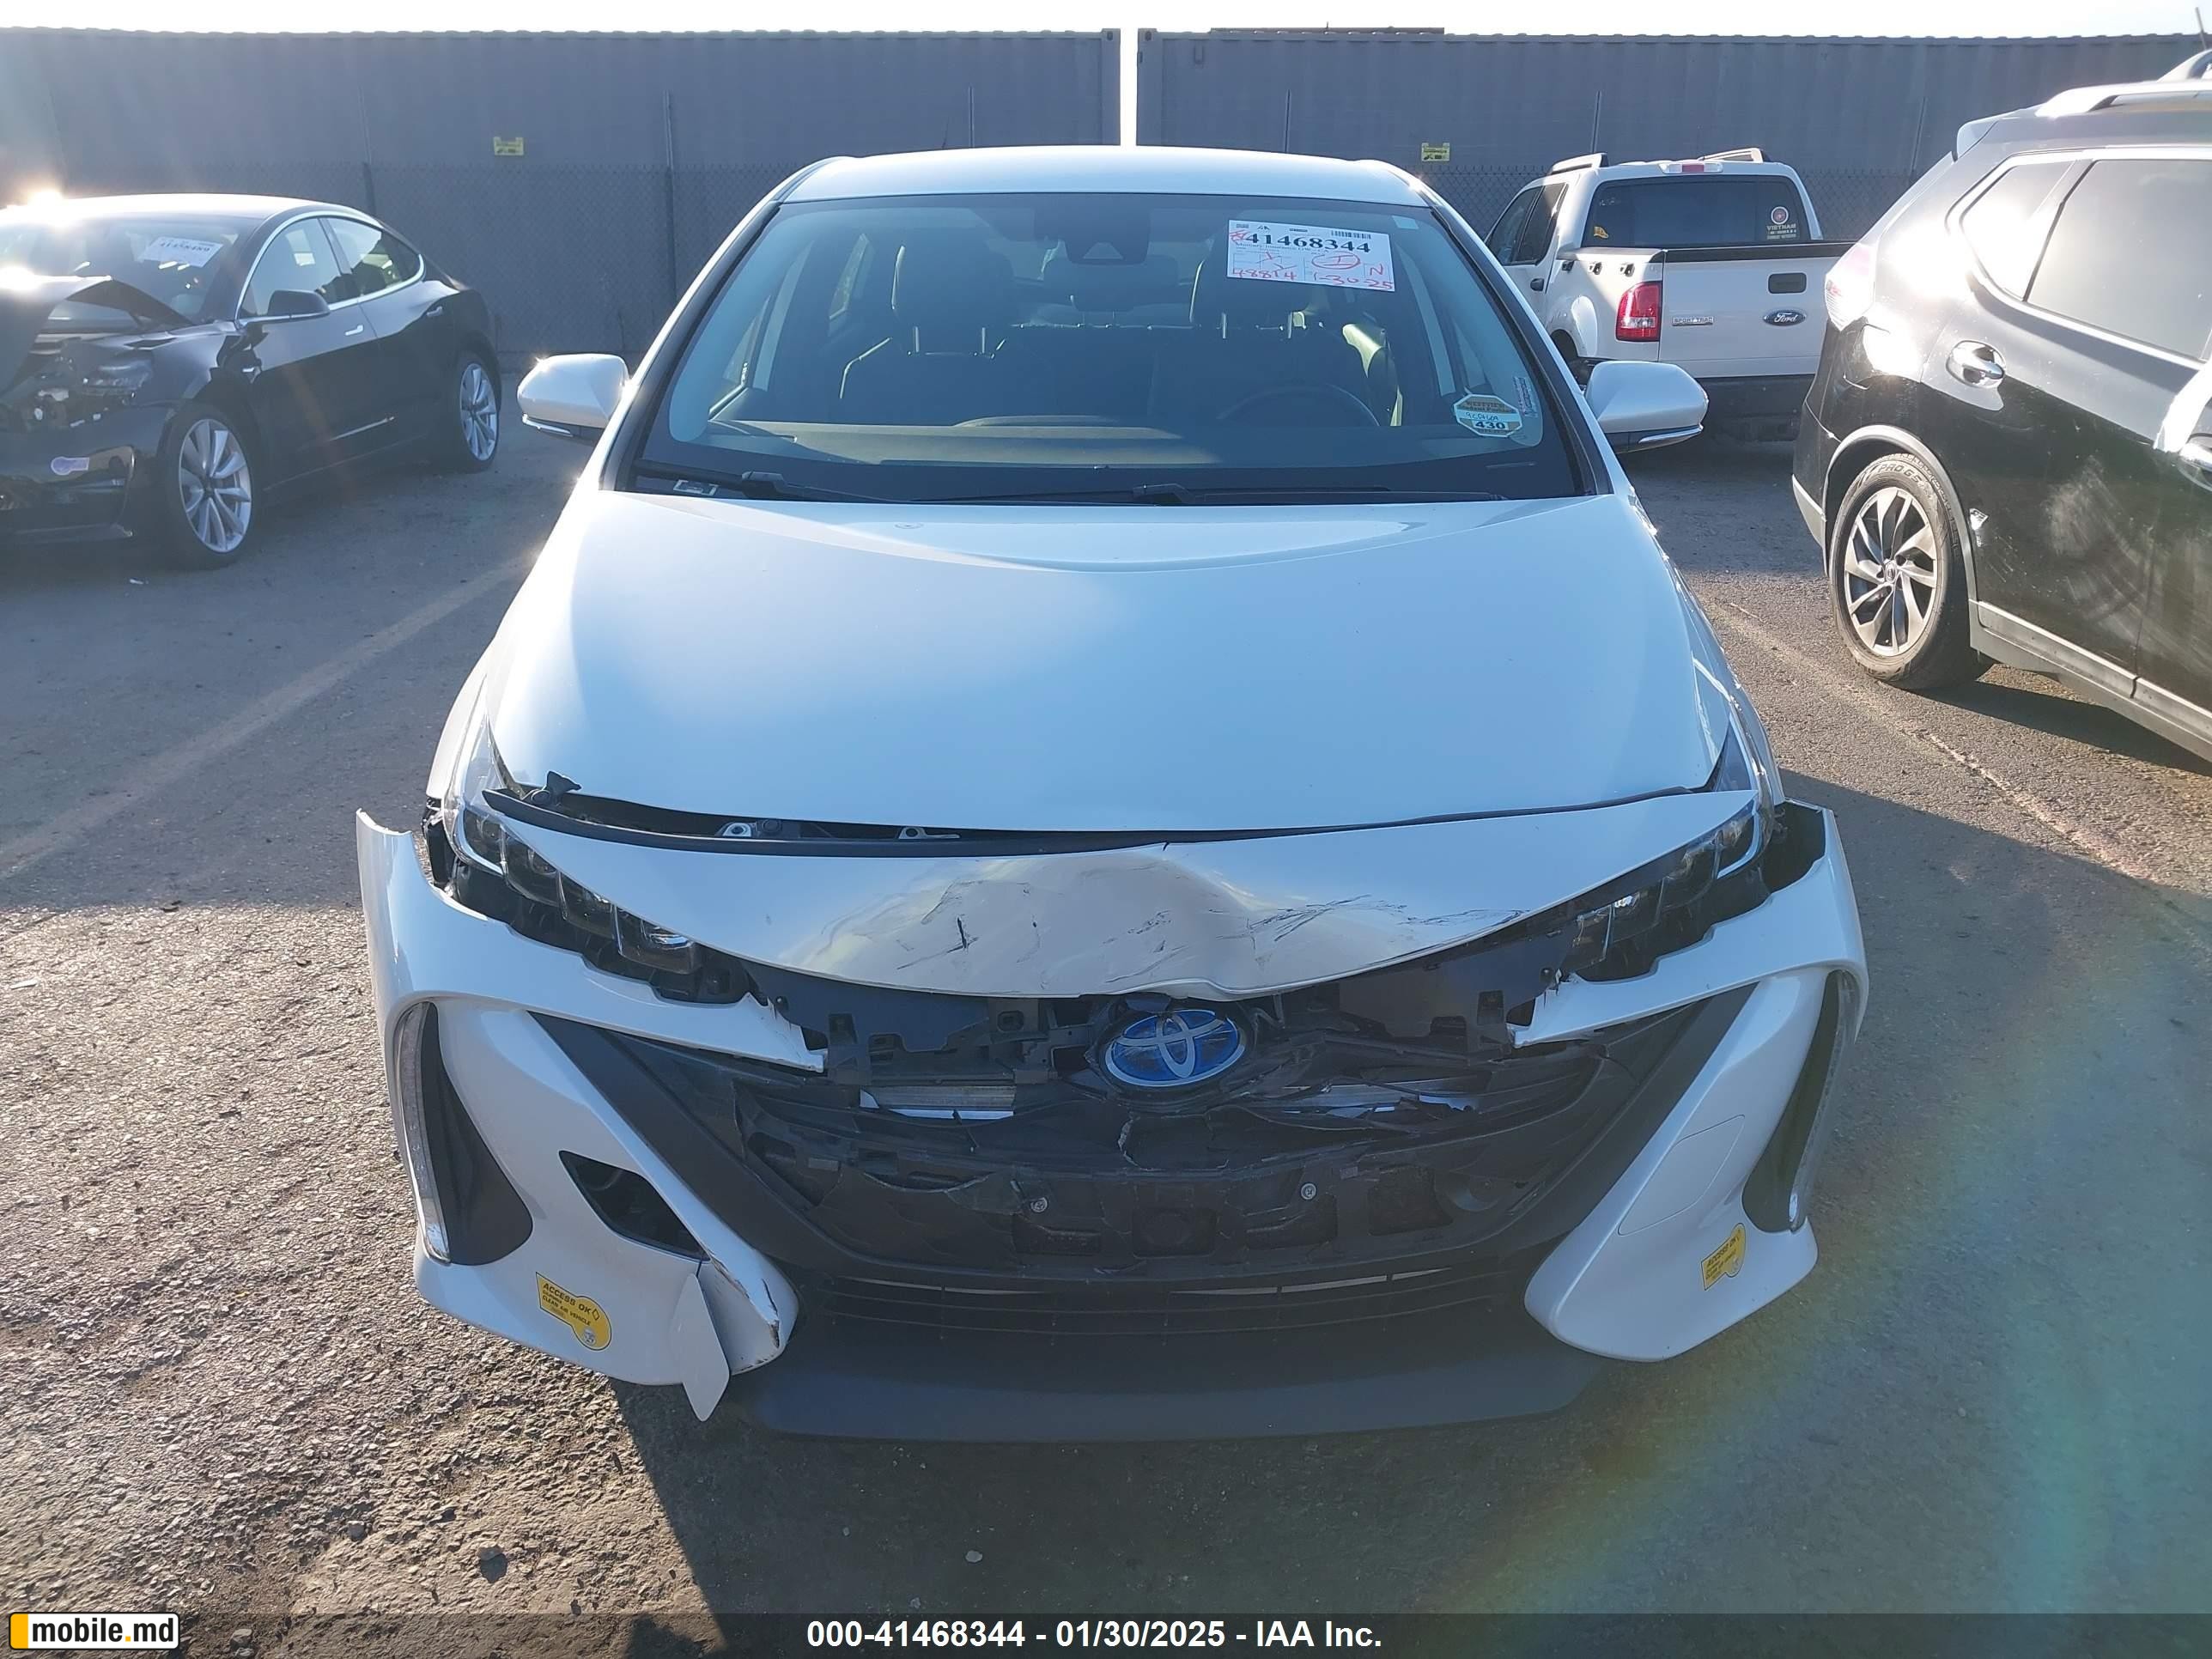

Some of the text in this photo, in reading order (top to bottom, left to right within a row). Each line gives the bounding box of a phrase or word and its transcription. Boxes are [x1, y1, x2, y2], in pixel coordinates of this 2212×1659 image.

[1245, 234, 1371, 252] 41468344
[1774, 312, 1799, 323] Ford
[543, 1283, 576, 1306] ACCESS
[578, 1304, 592, 1315] OK
[569, 1311, 592, 1326] VEHICLE
